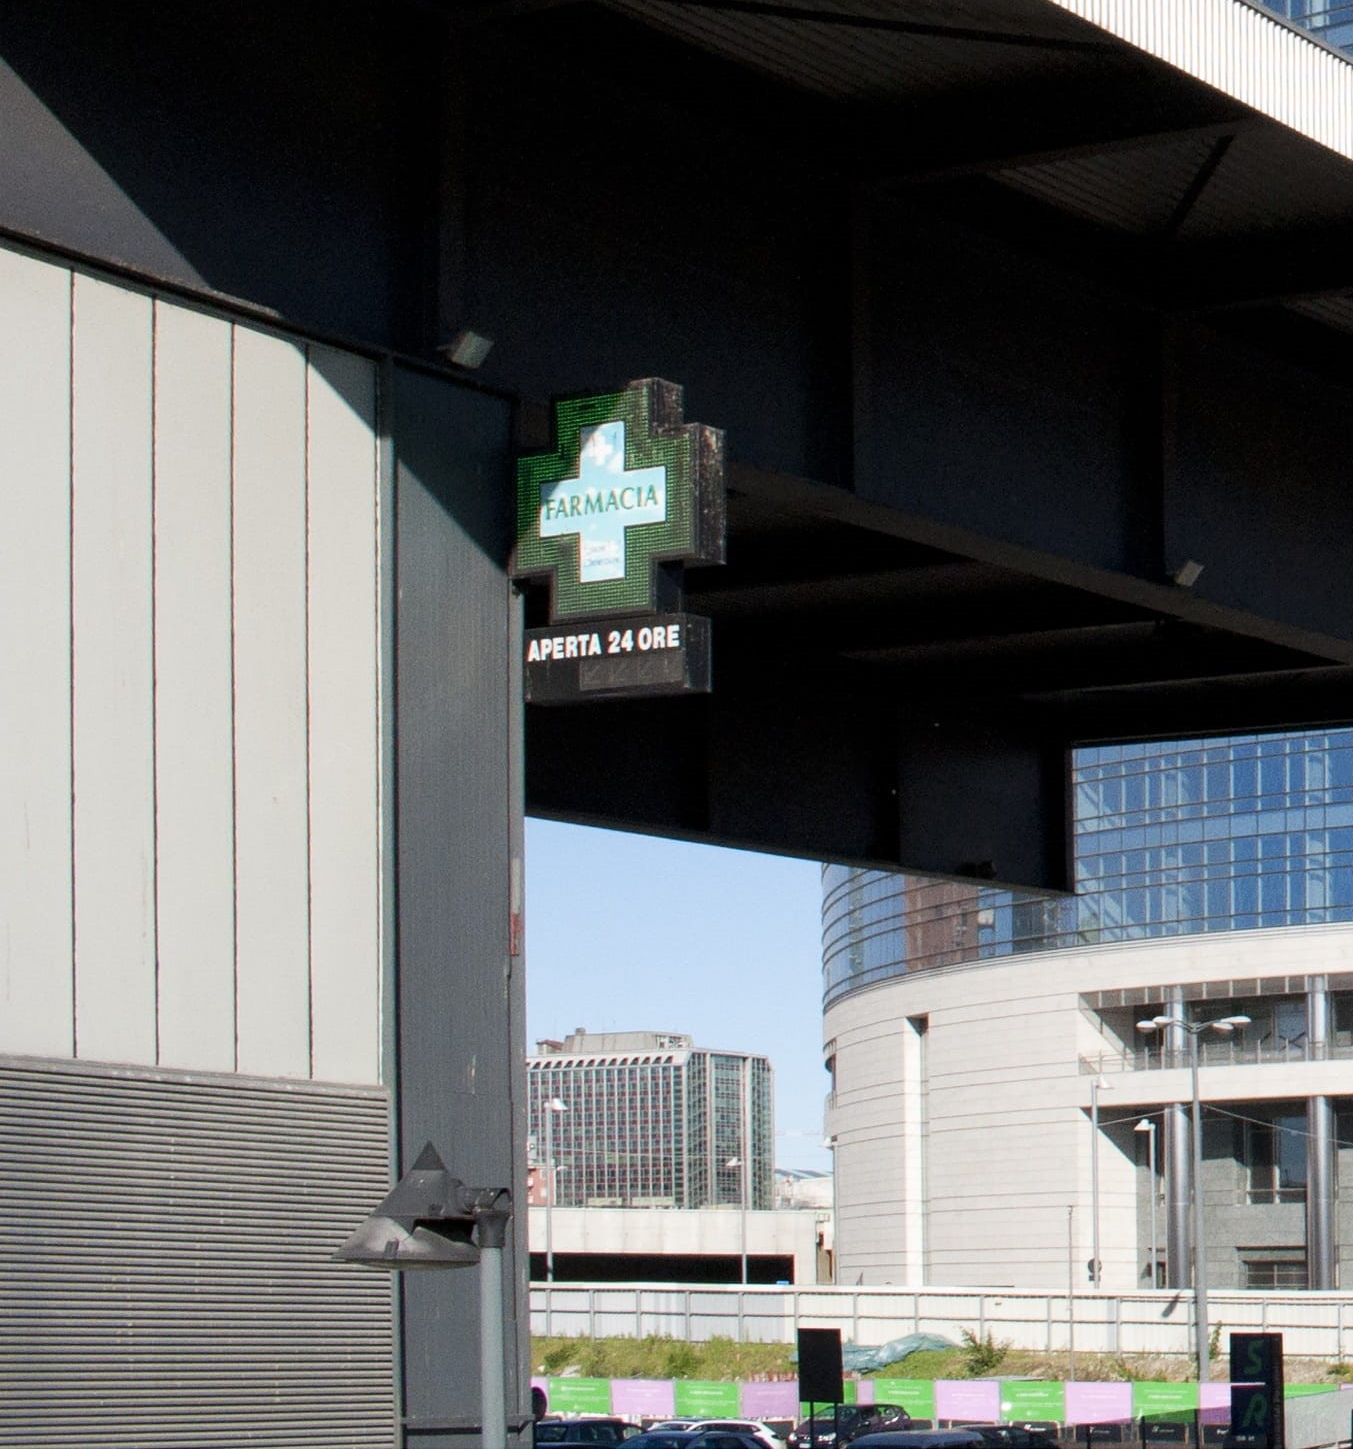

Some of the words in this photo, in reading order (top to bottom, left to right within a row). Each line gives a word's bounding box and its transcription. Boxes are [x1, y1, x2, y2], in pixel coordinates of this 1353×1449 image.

[543, 484, 659, 521] FARMACIA
[526, 633, 602, 662] APERTA
[608, 629, 634, 654] 24
[637, 624, 680, 651] ORE
[1243, 1339, 1264, 1375] S
